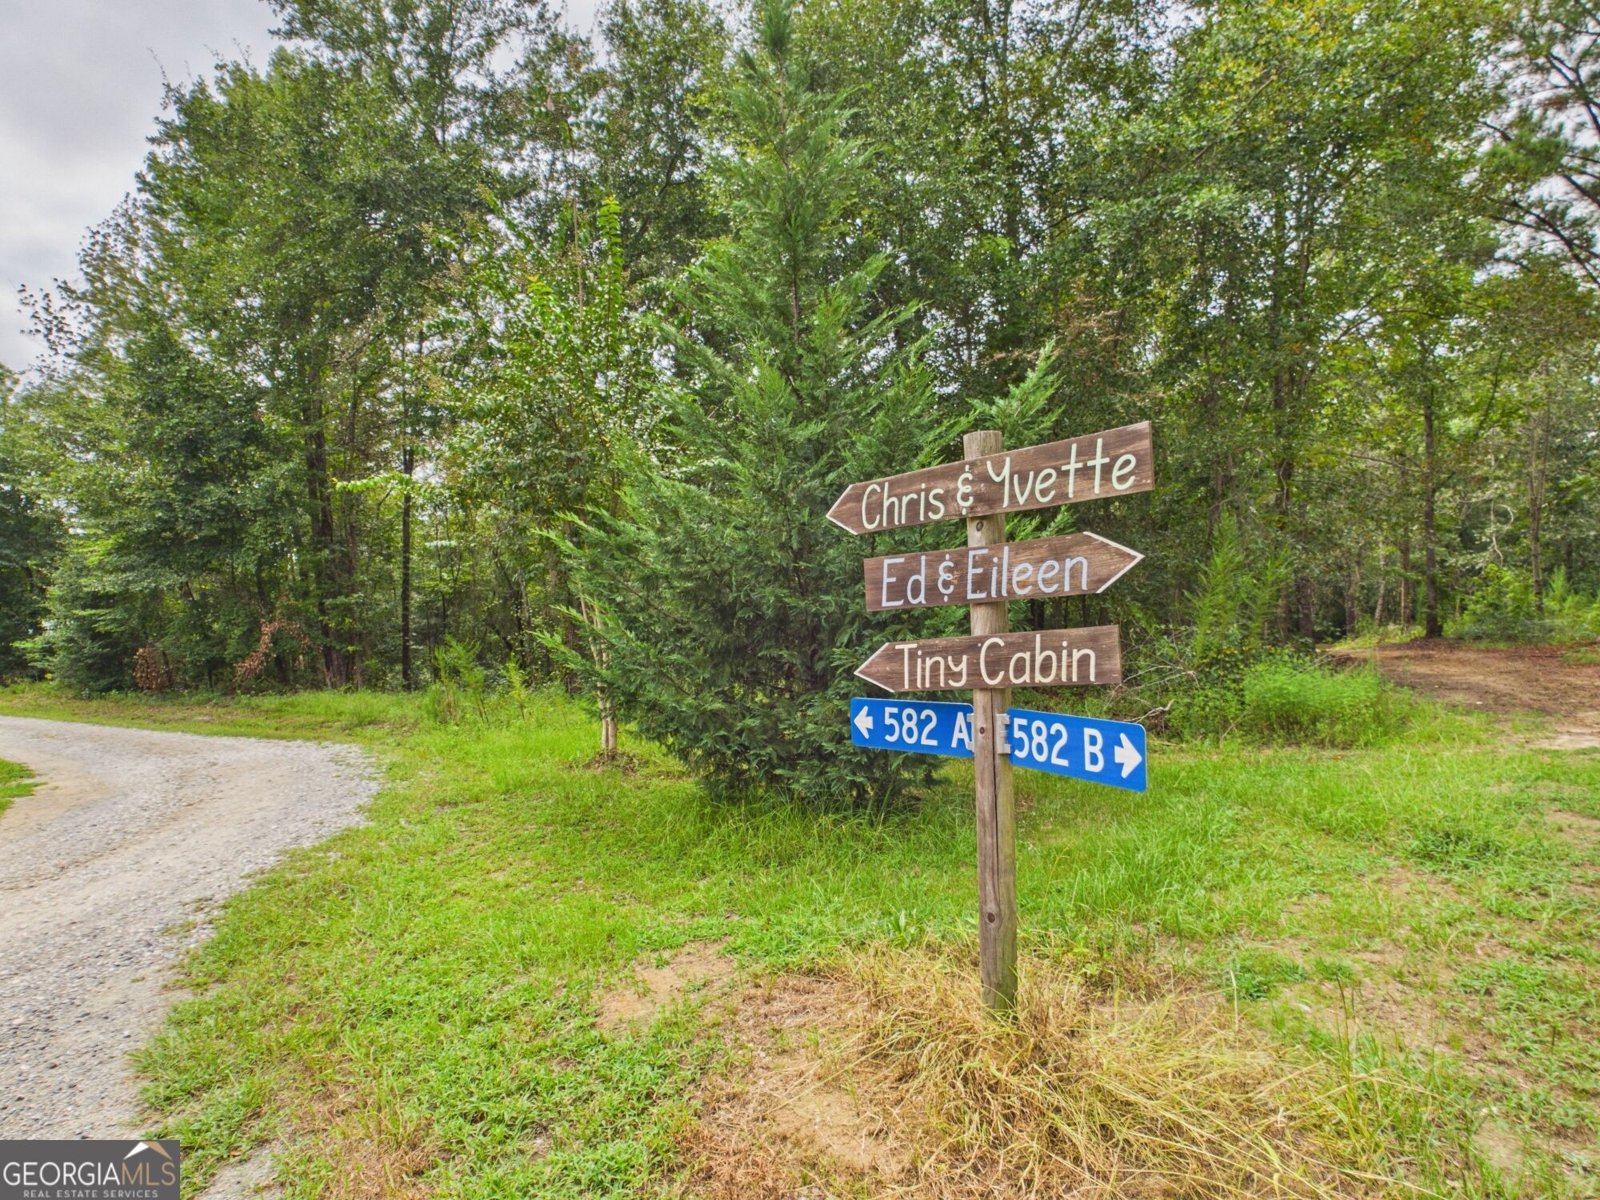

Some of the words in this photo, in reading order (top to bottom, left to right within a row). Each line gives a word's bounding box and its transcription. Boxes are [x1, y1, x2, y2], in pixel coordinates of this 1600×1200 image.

[861, 482, 945, 530] Chris
[957, 465, 974, 515] &
[986, 438, 1137, 508] Yvette
[881, 555, 926, 607] Ed
[937, 554, 955, 602] &
[967, 546, 1089, 600] Eileen
[895, 643, 968, 689] Tiny
[979, 633, 1096, 686] Cabin
[884, 707, 938, 747] 582
[951, 712, 969, 749] A
[1013, 718, 1069, 767] 582
[1084, 727, 1104, 773] B
